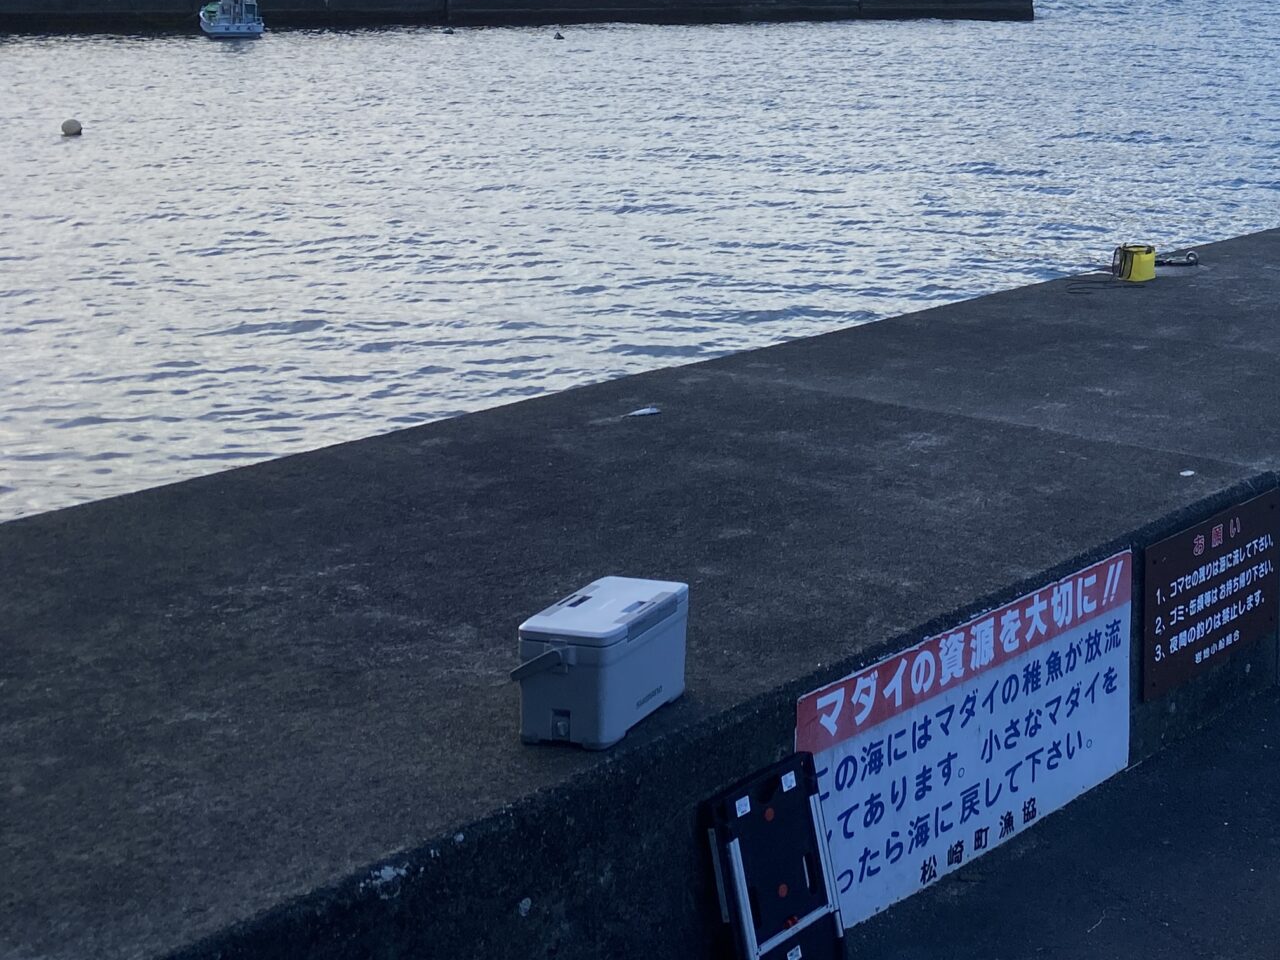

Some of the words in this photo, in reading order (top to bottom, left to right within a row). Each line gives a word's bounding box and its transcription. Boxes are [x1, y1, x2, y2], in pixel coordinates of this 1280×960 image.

[1193, 517, 1241, 556] お願い
[827, 666, 1118, 844] てあります。小さなマダイを
[919, 797, 1037, 886] 松崎町漁協
